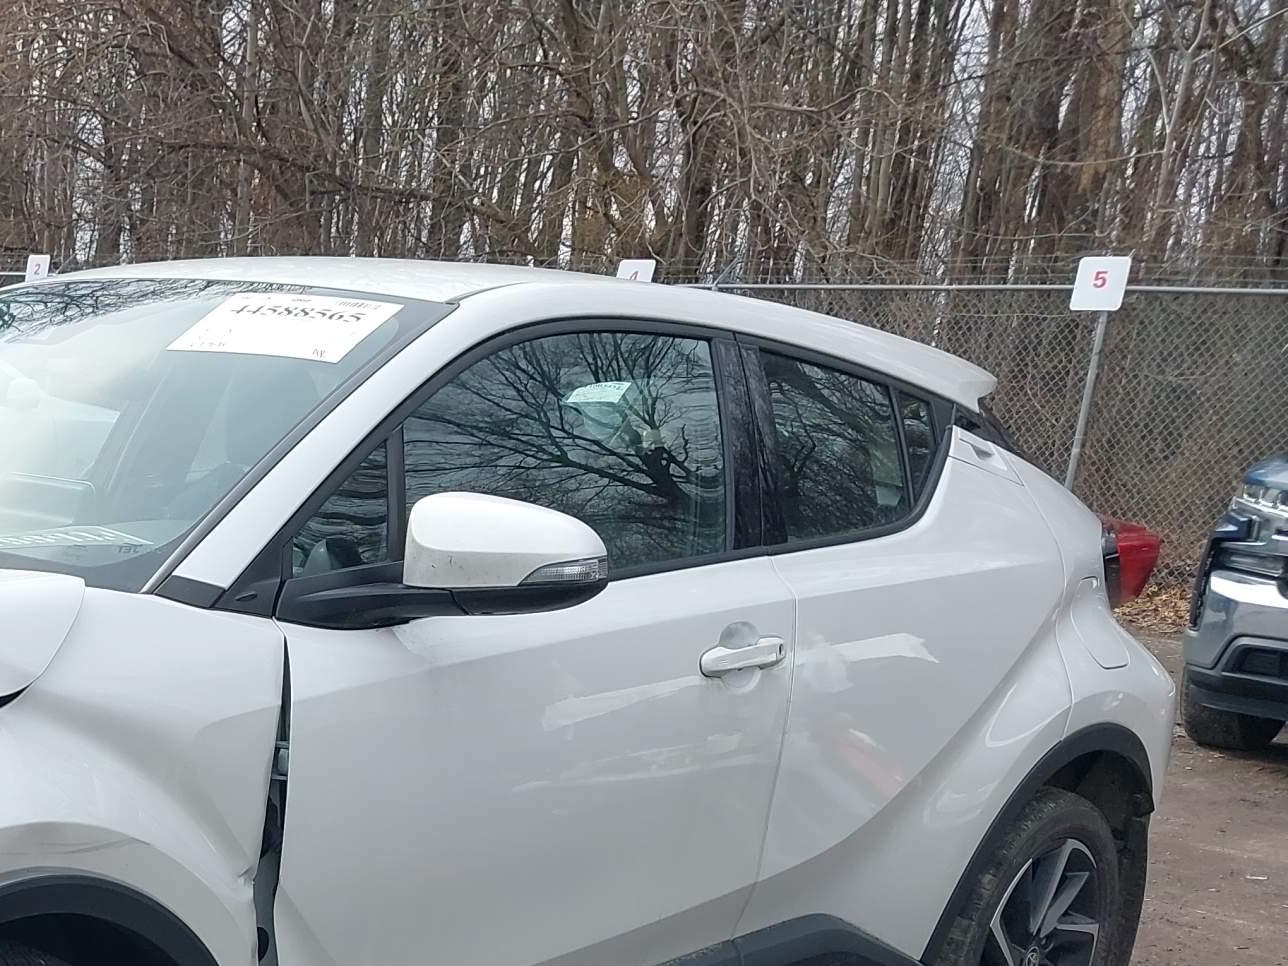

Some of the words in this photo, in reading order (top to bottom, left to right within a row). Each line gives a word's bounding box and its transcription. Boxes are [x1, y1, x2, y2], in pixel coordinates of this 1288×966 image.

[34, 263, 41, 275] 2
[1093, 270, 1109, 289] 5
[231, 304, 367, 323] 44588565
